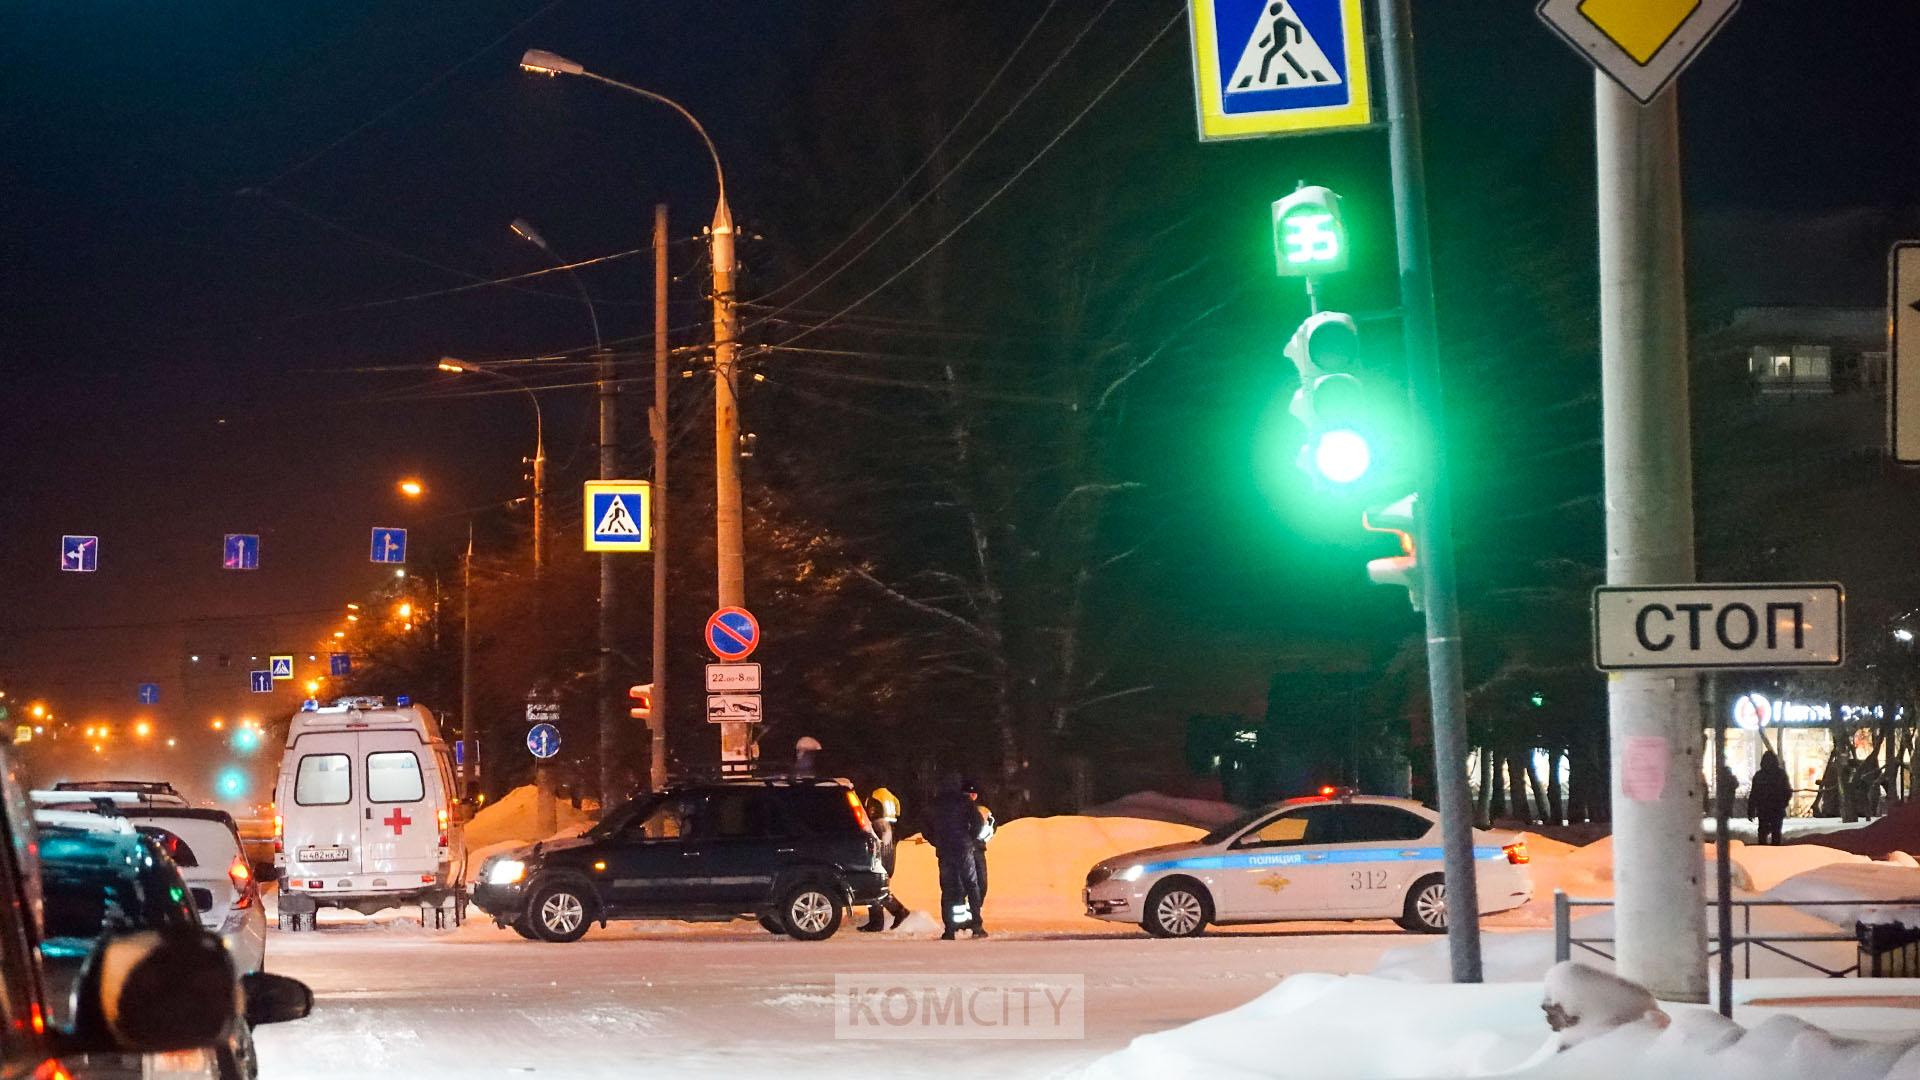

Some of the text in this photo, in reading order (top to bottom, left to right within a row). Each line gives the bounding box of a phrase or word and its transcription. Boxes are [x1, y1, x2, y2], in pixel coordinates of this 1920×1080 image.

[1286, 214, 1338, 262] 35
[1635, 602, 1804, 651] СТОП
[1248, 854, 1302, 865] ПОЛИЦИЯ
[1350, 870, 1387, 890] 312
